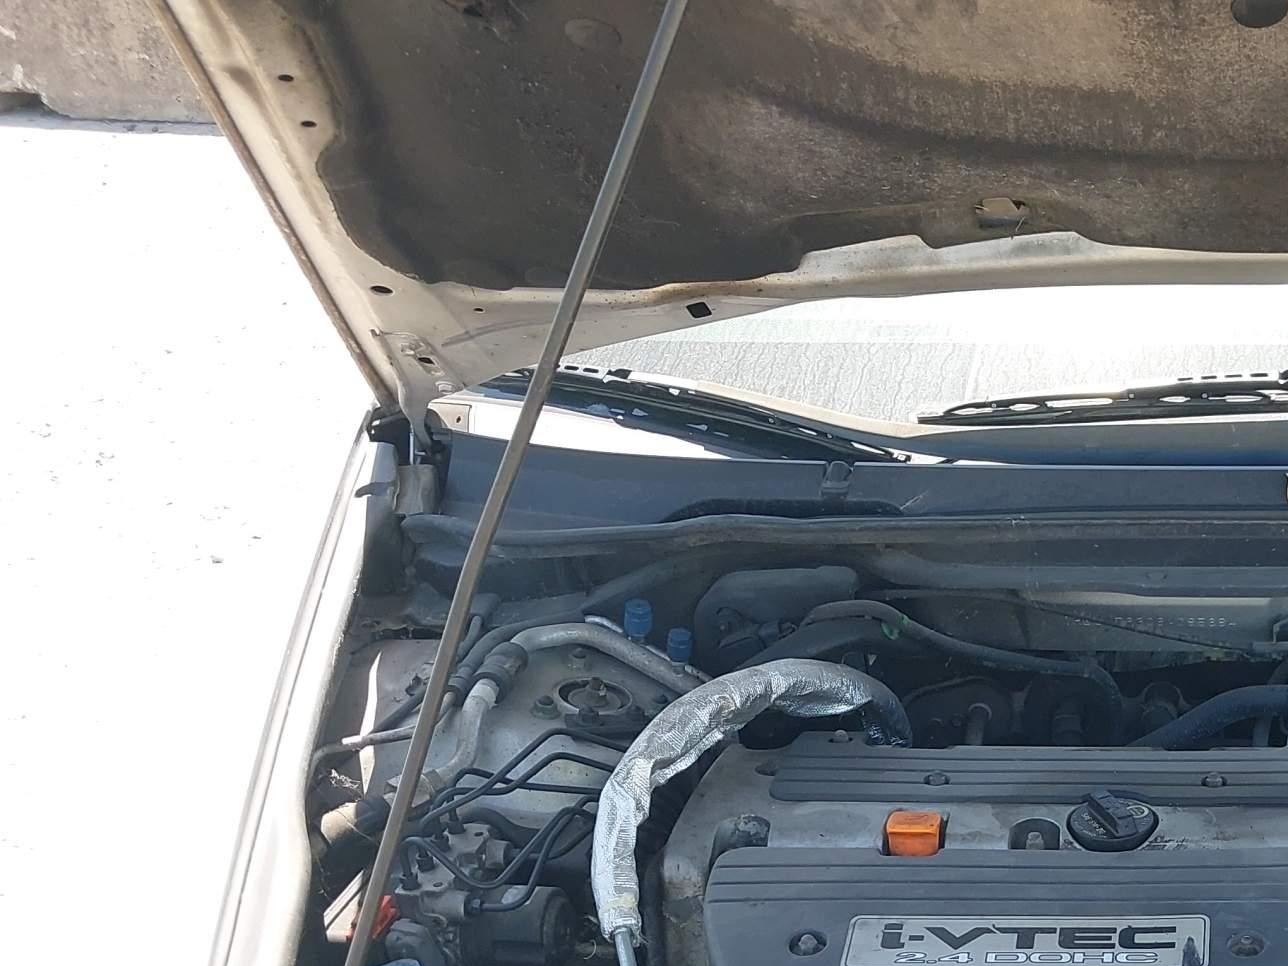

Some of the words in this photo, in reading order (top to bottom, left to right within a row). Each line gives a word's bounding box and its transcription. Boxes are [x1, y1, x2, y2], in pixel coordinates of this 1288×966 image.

[880, 923, 1176, 950] i-VTEC
[894, 952, 973, 964] 2.4
[984, 952, 1159, 964] DOHC
